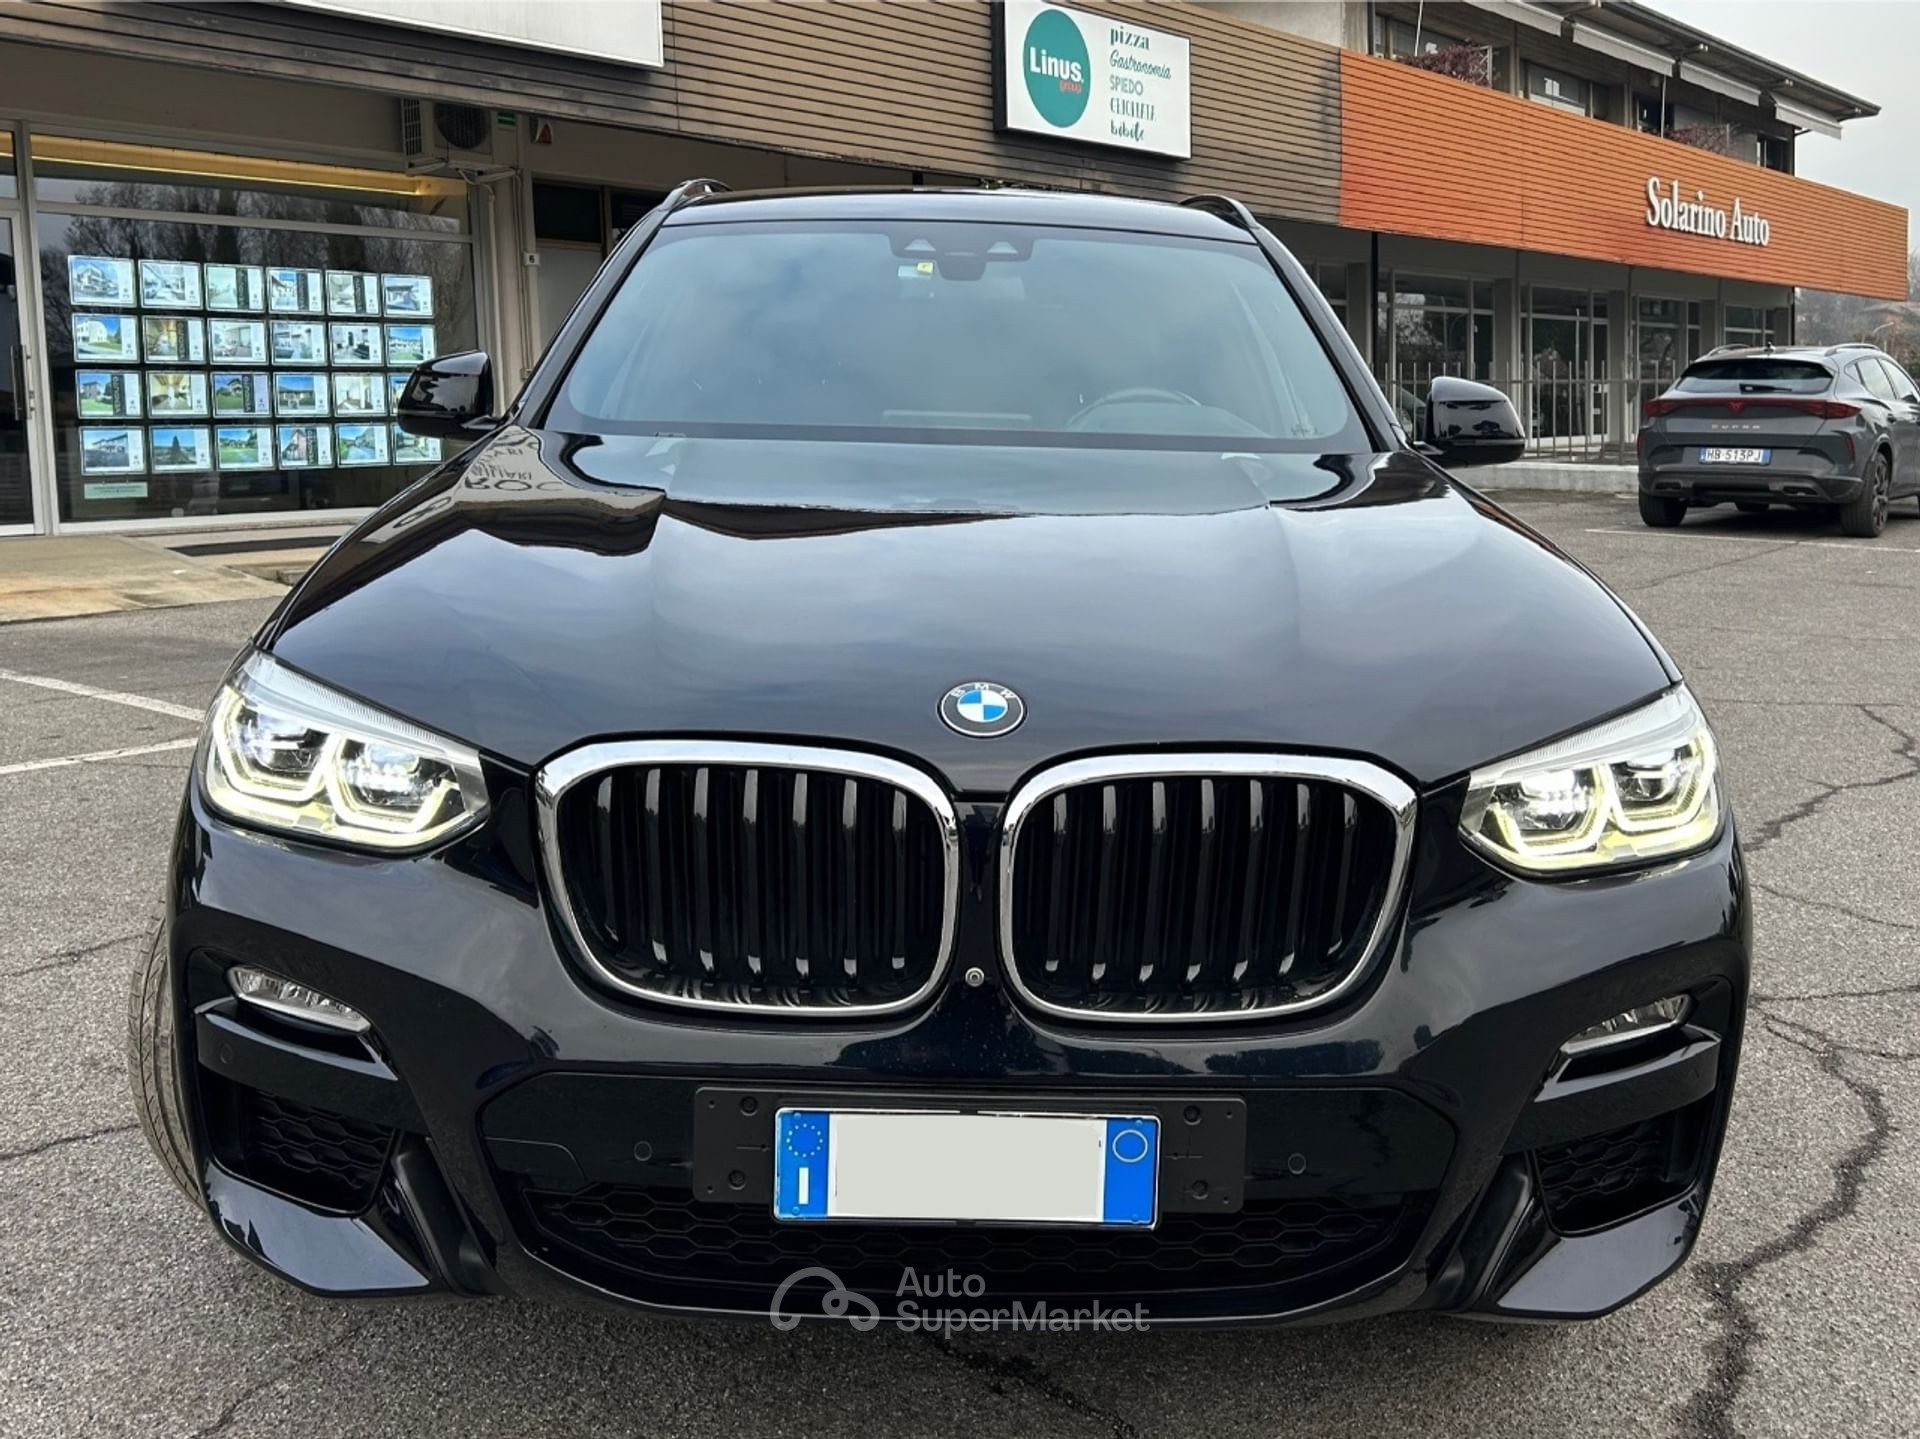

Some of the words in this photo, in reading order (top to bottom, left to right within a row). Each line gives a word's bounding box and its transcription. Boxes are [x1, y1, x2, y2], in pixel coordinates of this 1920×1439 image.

[1110, 26, 1150, 50] pizza
[1109, 49, 1172, 79] Gastronomia
[1110, 74, 1144, 96] SPIEDO
[1647, 176, 1726, 238] Solarino
[1729, 197, 1770, 246] Auto
[950, 683, 1017, 699] BMW
